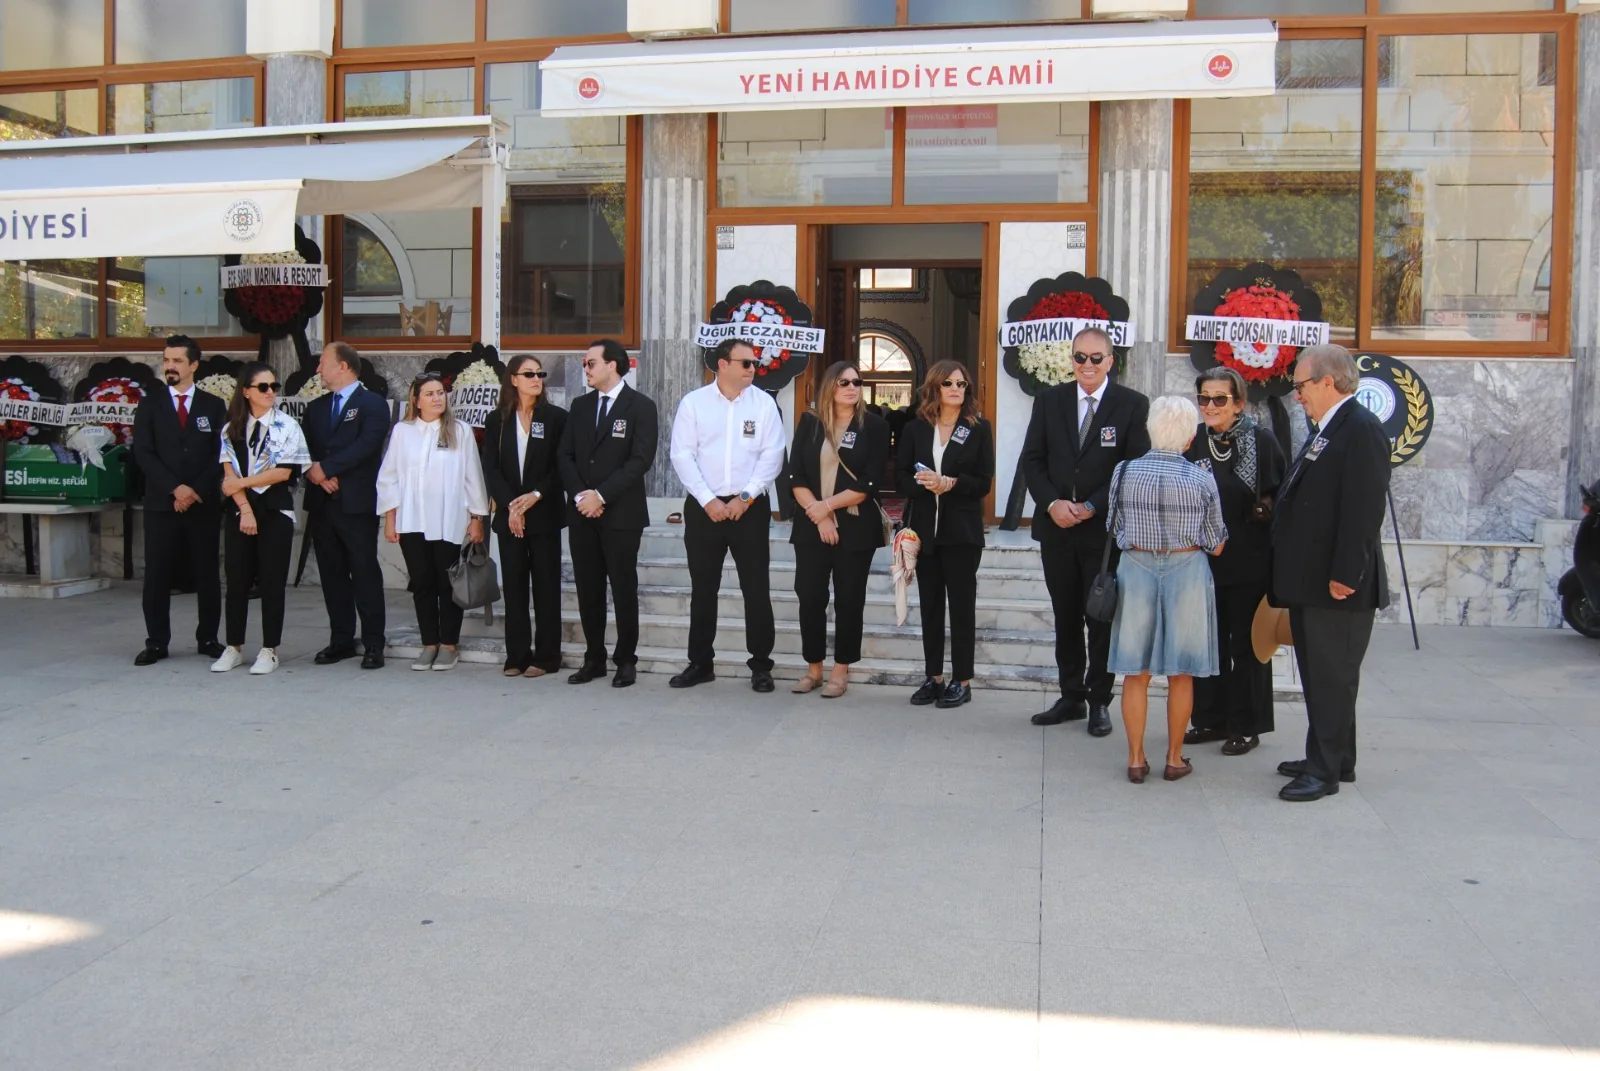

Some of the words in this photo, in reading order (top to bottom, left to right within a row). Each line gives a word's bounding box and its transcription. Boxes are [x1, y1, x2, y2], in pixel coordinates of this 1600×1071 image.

[740, 68, 804, 95] YENİ
[811, 63, 958, 92] HAMİDİYE
[966, 59, 1055, 87] CAMİİ
[283, 267, 289, 284] &
[291, 267, 322, 286] RESORT
[700, 326, 736, 338] UĞUR
[740, 325, 820, 342] ECZANESİ
[1008, 321, 1074, 345] GÖRYAKIN
[1192, 319, 1229, 341] AHMET
[1230, 318, 1274, 344] GÖKSAN
[1276, 328, 1287, 341] ve
[1289, 322, 1323, 346] AİLESİ
[758, 338, 818, 351] SAĞTÜRK
[460, 384, 498, 406] DÖĞER
[31, 403, 65, 424] BİRLİĞİ
[70, 404, 93, 415] ALİM
[28, 476, 47, 485] DEFİN
[63, 475, 87, 486] ŞEFLİĞİ
